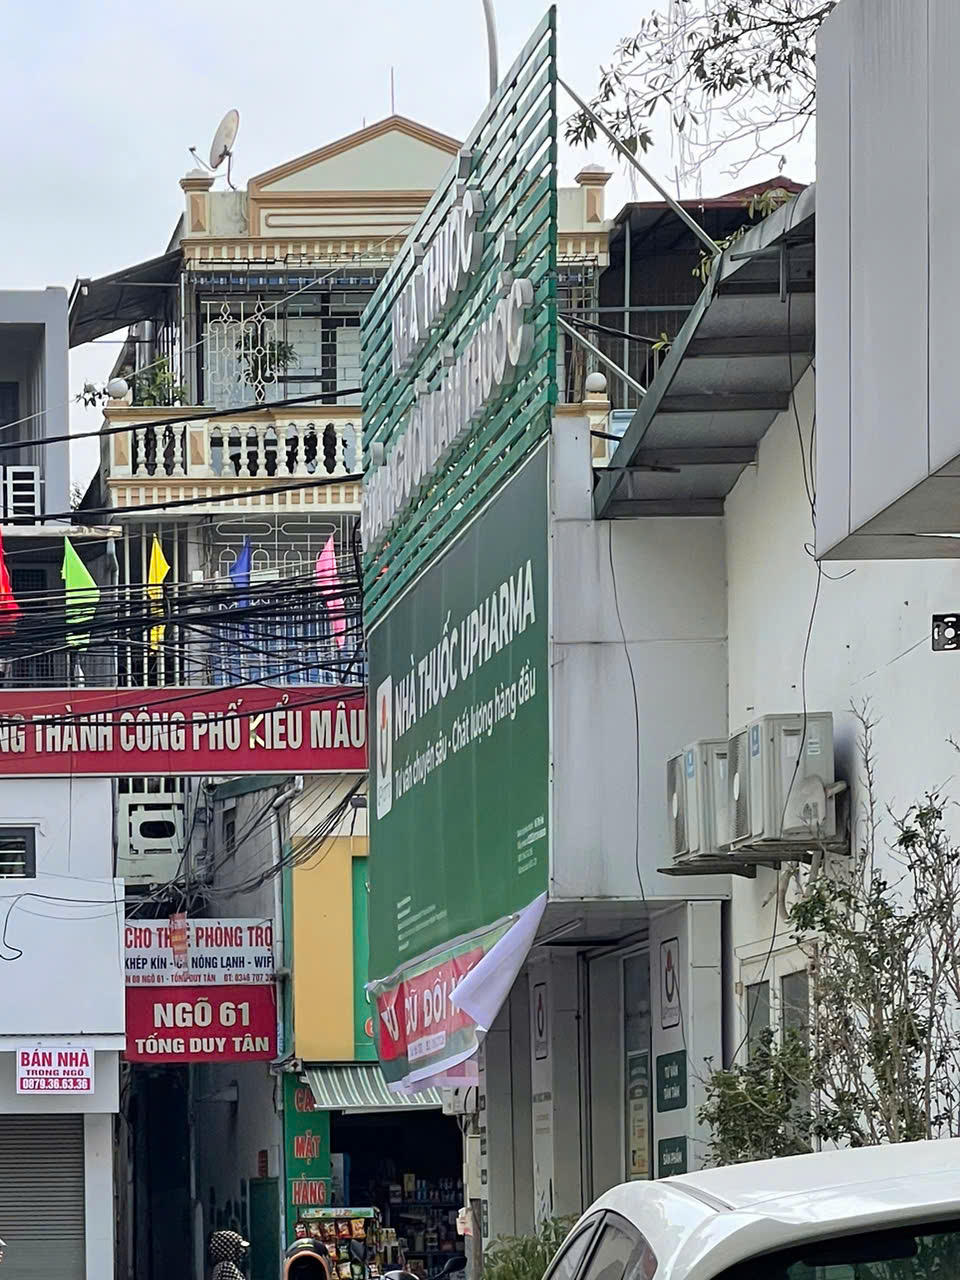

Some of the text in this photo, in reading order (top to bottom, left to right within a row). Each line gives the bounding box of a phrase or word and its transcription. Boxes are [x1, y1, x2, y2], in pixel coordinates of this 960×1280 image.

[395, 559, 536, 741] NHÀ THUỐC UPHARMA
[452, 706, 470, 754] Chất
[470, 694, 493, 744] lượng
[494, 679, 517, 722] hàng
[518, 658, 537, 705] đầu
[32, 705, 113, 752] THÀNH
[119, 706, 186, 752] CÔNG
[192, 699, 243, 751] PHỐ
[249, 694, 303, 749] KIỂU
[124, 926, 153, 949] CHO
[195, 920, 243, 949] PHÒNG
[247, 925, 273, 952] TRỌ
[150, 954, 167, 970] KÍN
[191, 954, 218, 969] NÓNG
[221, 955, 246, 972] LẠNH
[153, 996, 250, 1028] NGÕ 61
[21, 1048, 90, 1067] BÁN NHÀ
[135, 1032, 185, 1054] TỐNG
[190, 1037, 227, 1053] DUY
[232, 1033, 270, 1052] TÂN
[22, 1078, 88, 1090] 0879.36.63.36
[294, 1130, 321, 1166] MẶT
[292, 1172, 327, 1206] HÀNG
